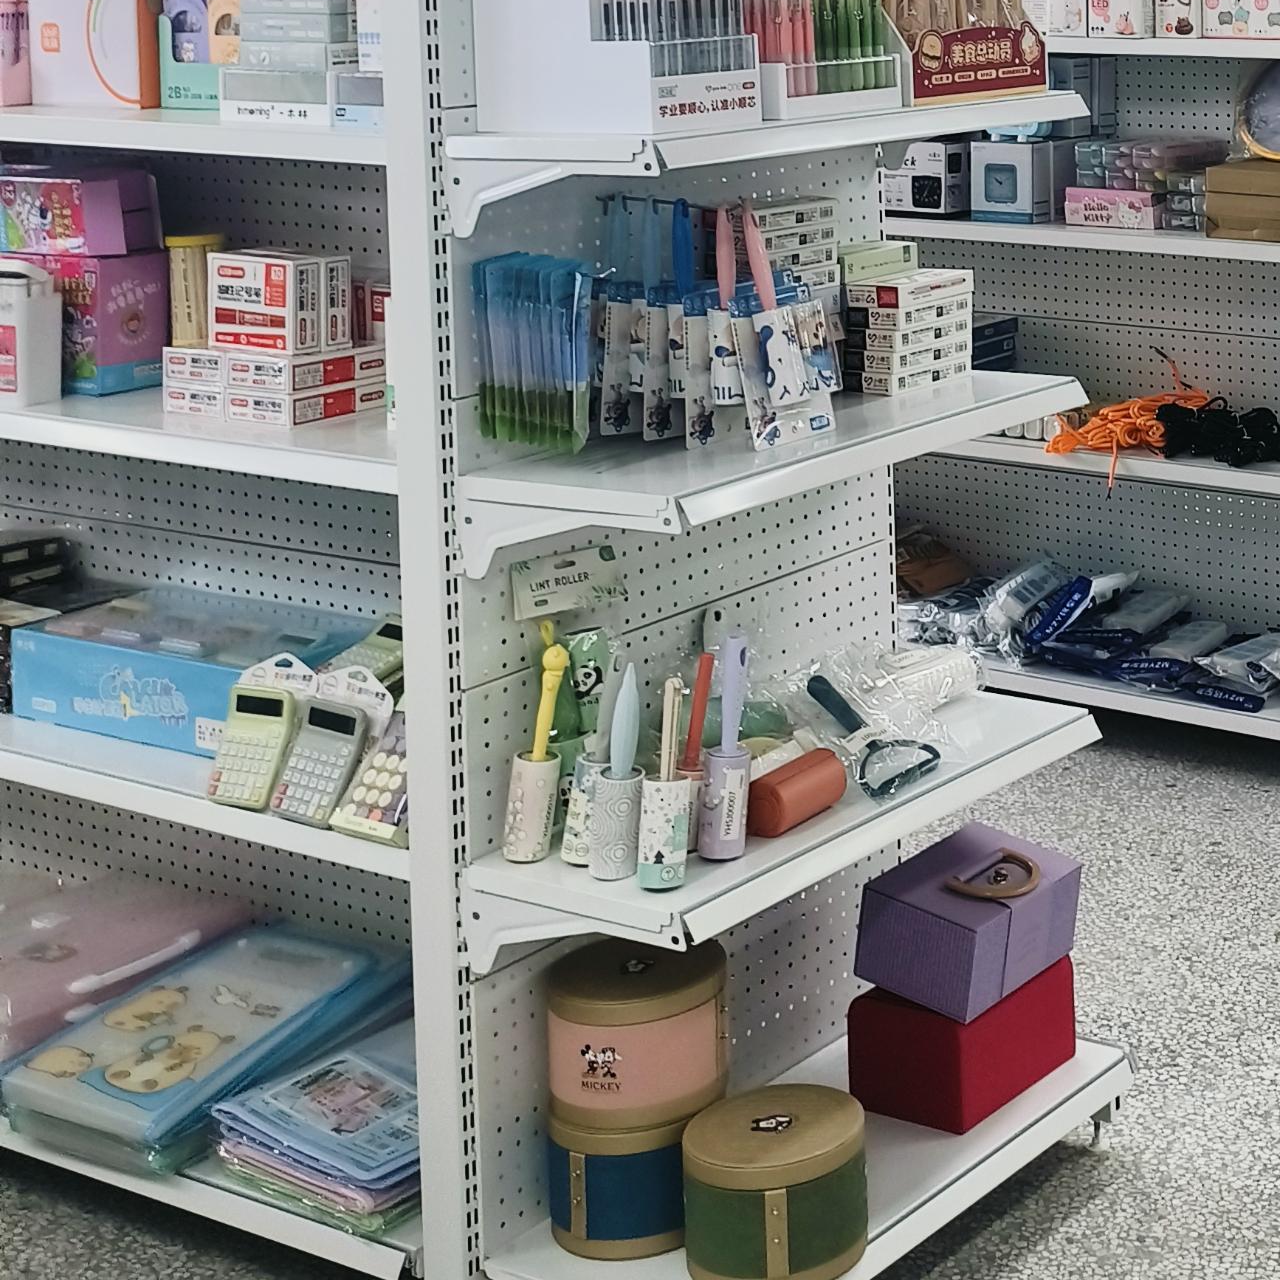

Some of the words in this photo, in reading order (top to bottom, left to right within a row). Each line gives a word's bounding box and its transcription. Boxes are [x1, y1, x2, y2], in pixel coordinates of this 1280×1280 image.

[1091, 0, 1109, 8] LED
[951, 40, 1011, 64] 美食总动员
[1083, 202, 1110, 212] Hello
[1083, 212, 1113, 224] Kitty
[529, 579, 551, 593] LINT
[554, 571, 590, 588] ROLLER
[580, 1079, 622, 1092] MICKEY
